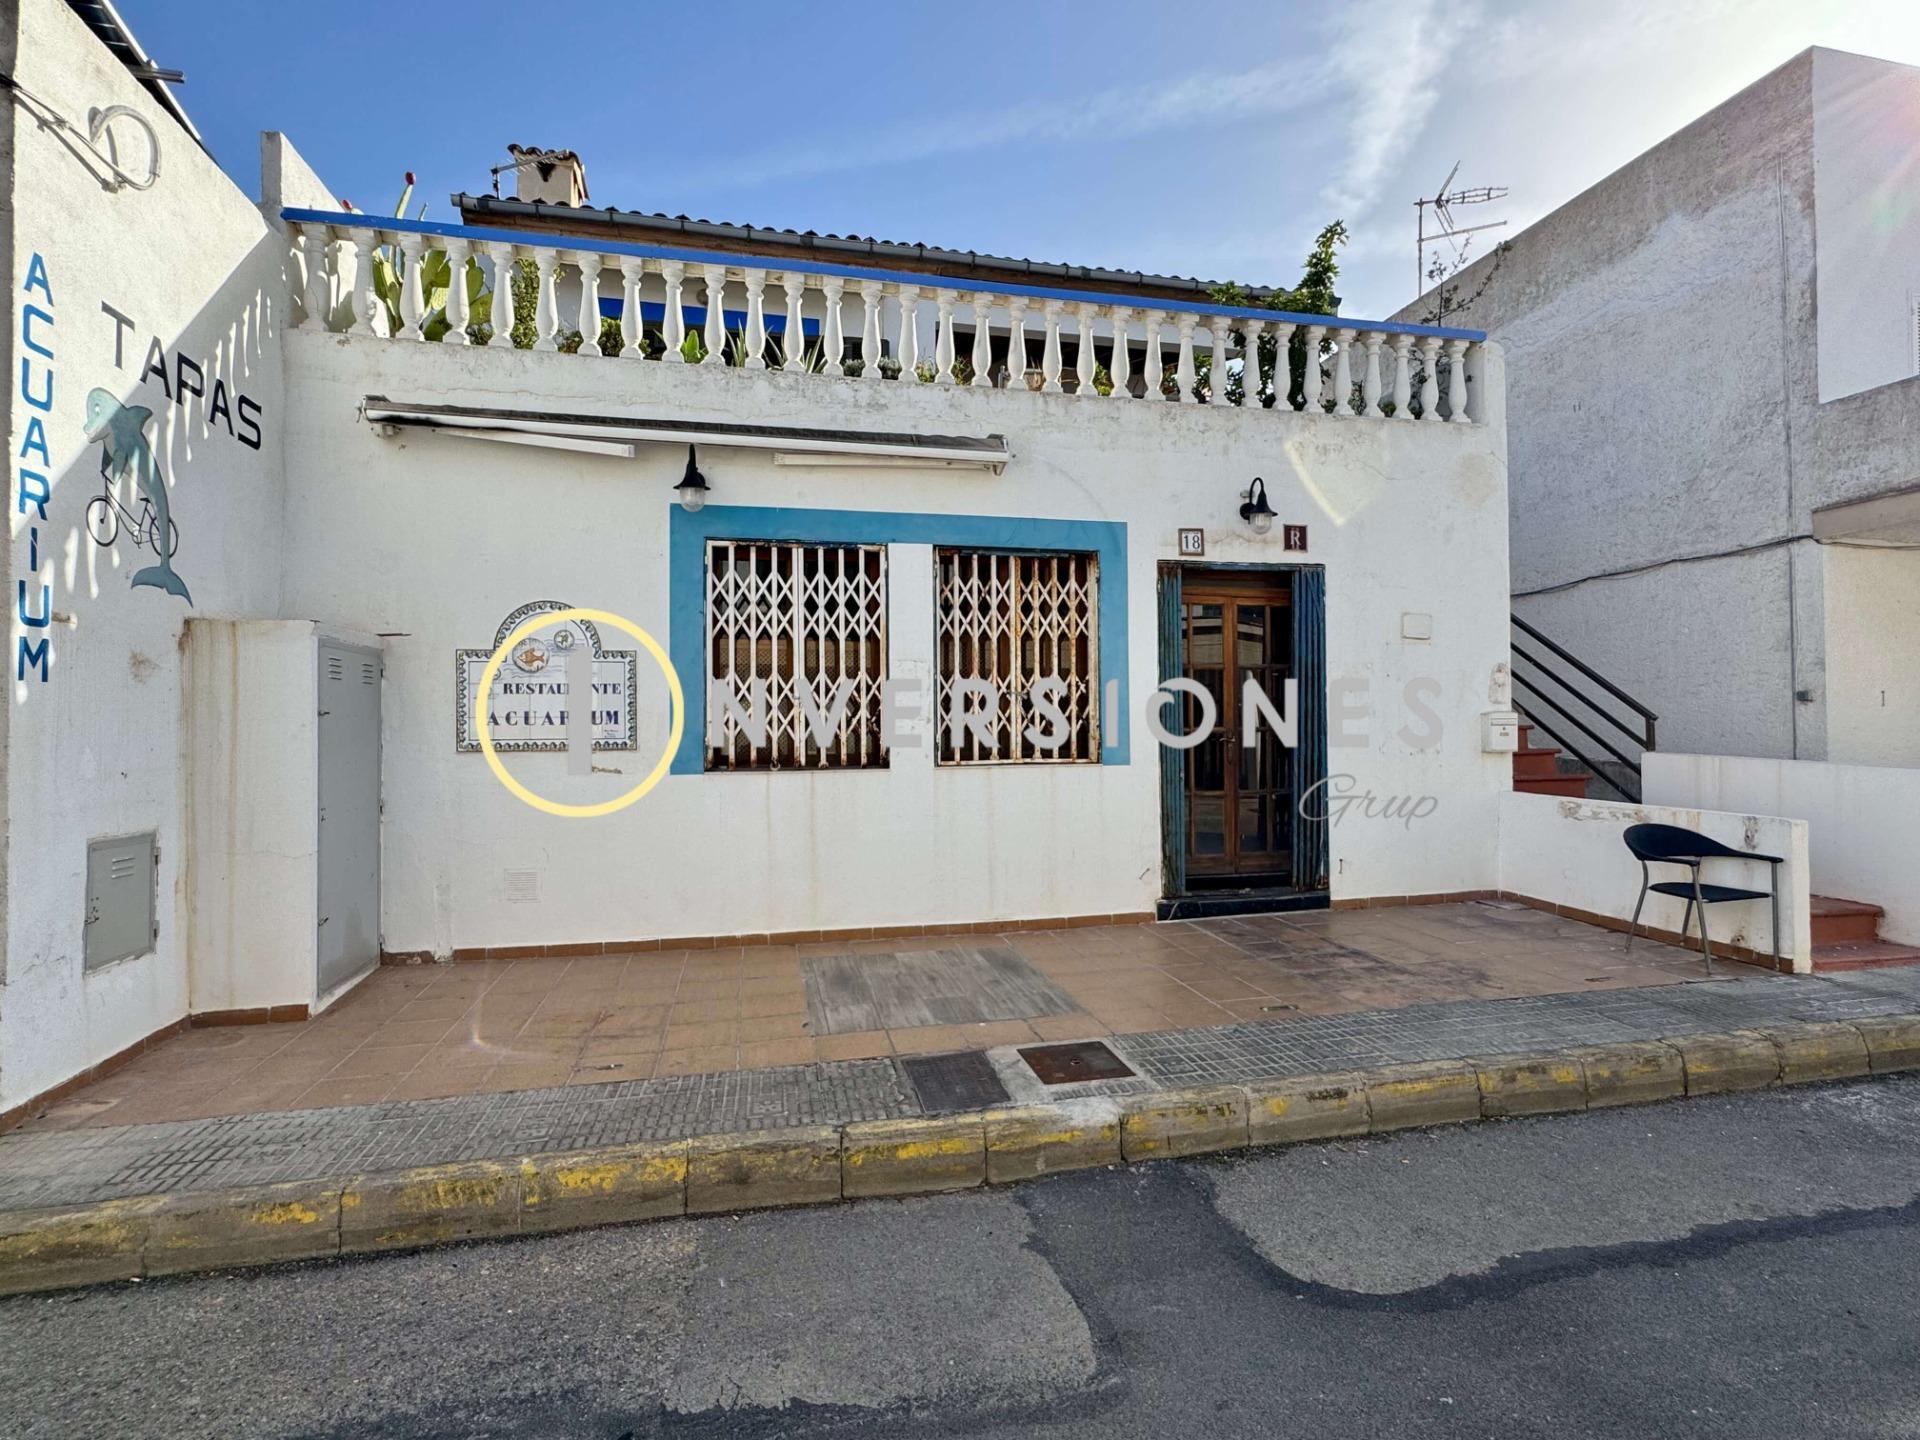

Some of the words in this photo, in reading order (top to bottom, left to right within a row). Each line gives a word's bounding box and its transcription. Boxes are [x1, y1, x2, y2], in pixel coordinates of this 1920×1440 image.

[101, 301, 262, 450] TAPAS
[17, 252, 54, 683] ACUARIUM
[1183, 534, 1201, 550] 18
[503, 683, 621, 694] RESTAUNTE
[487, 711, 619, 726] ACUARUM
